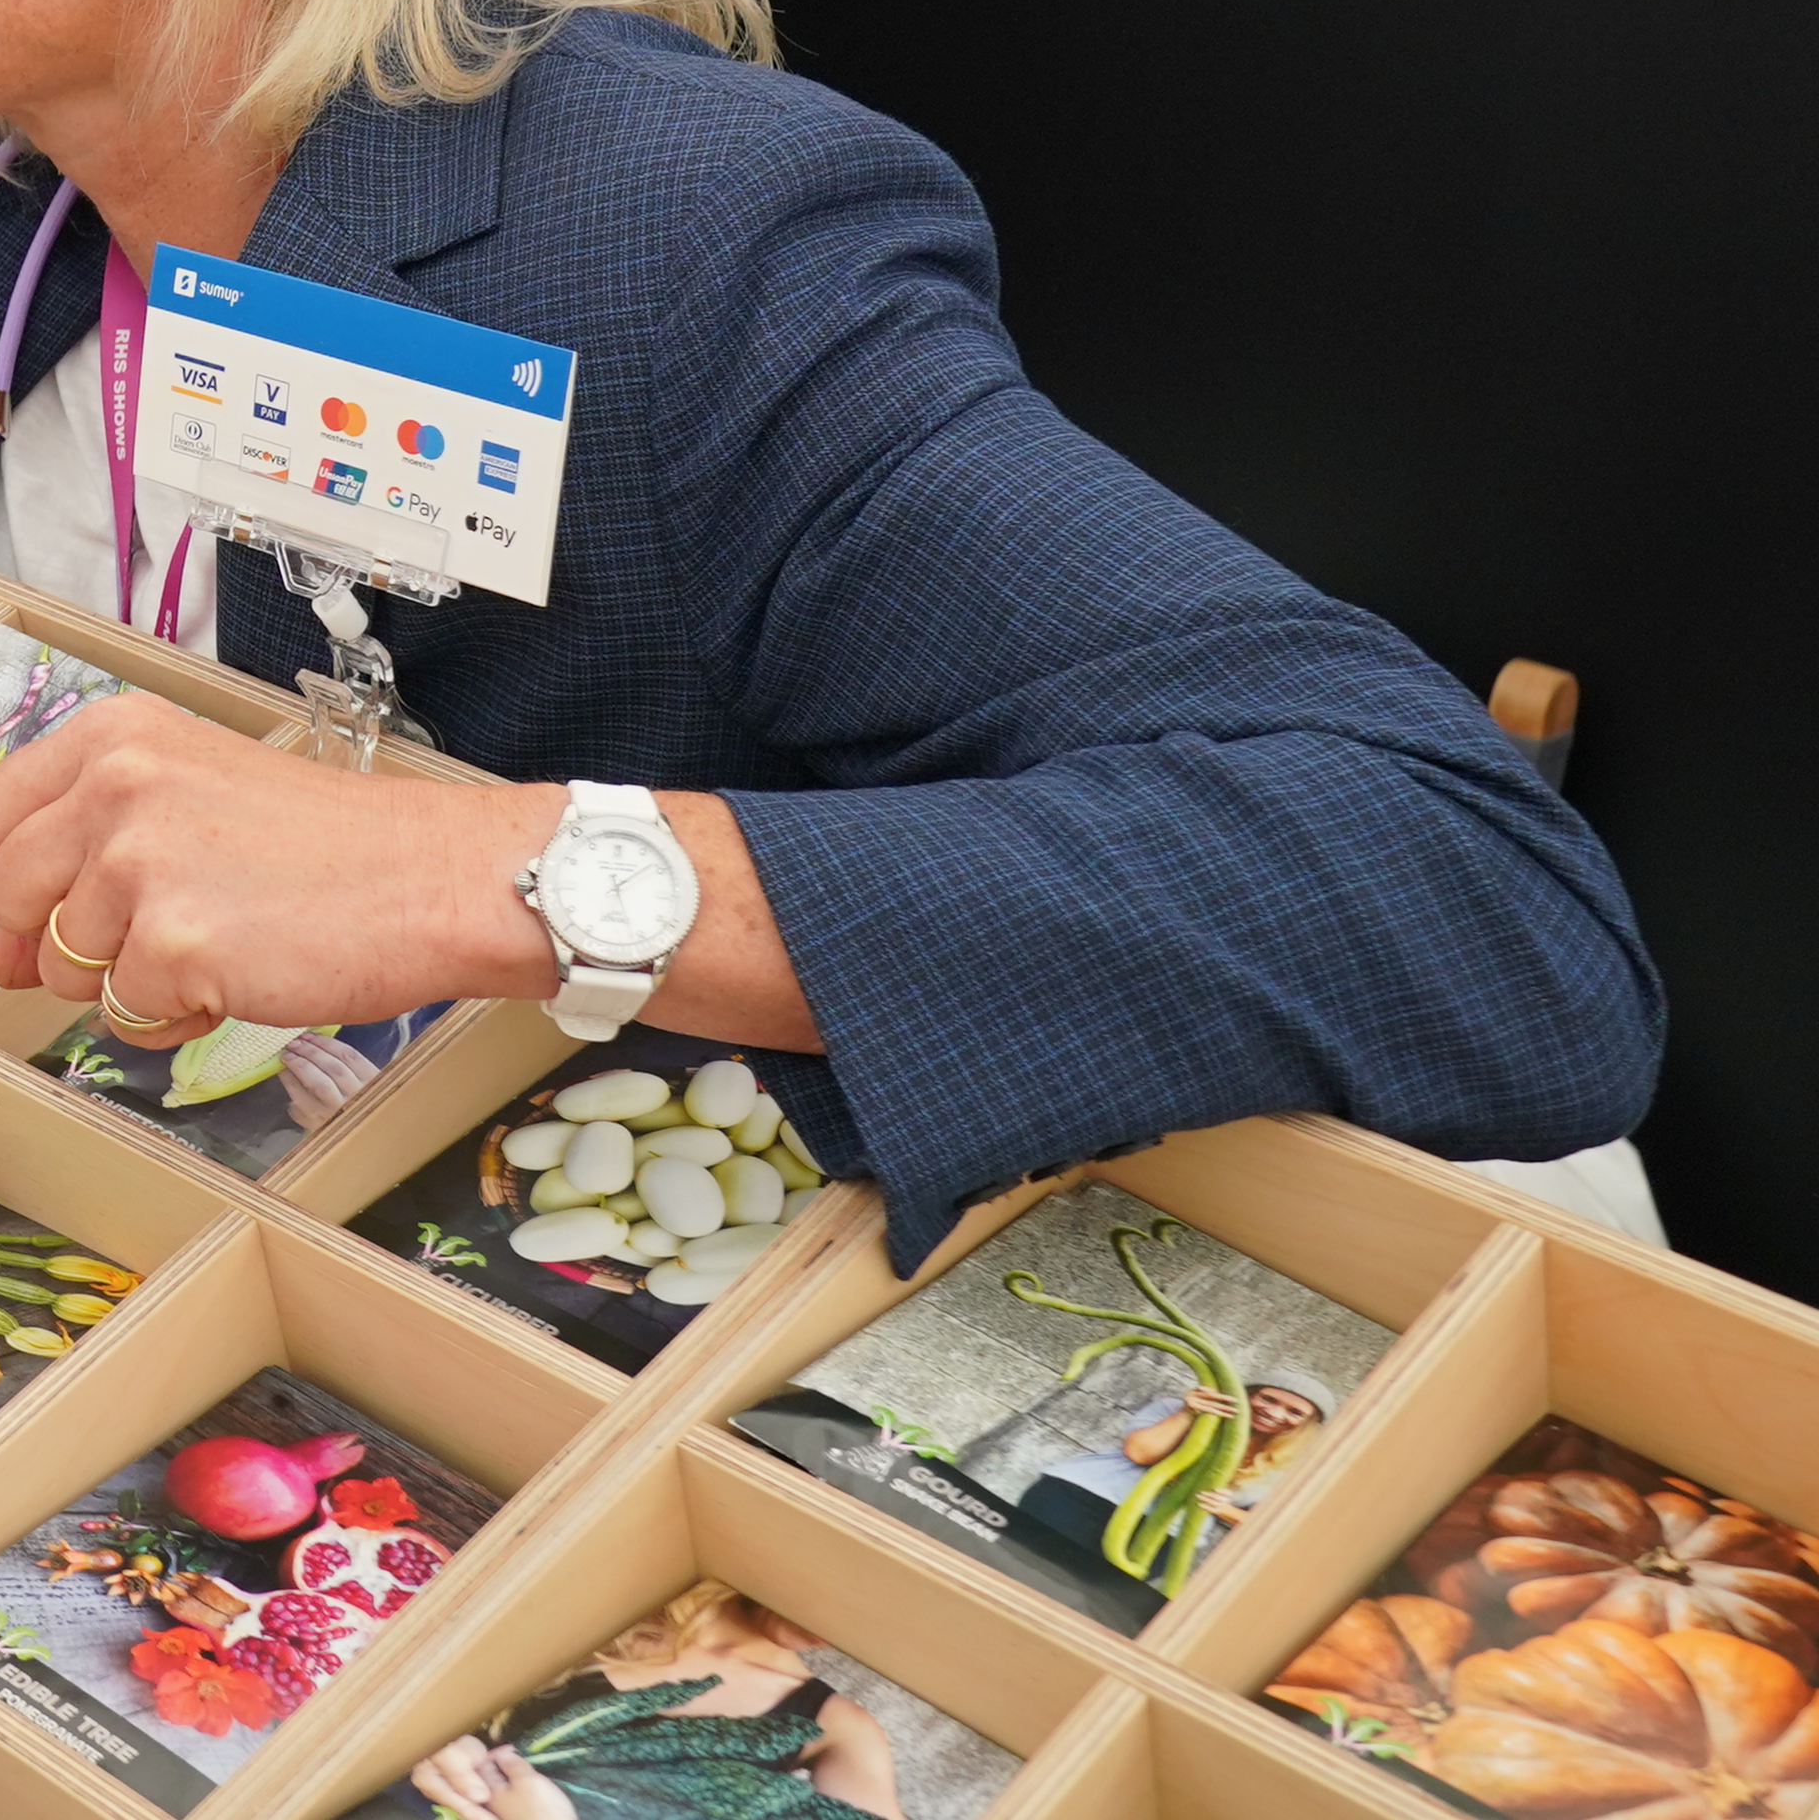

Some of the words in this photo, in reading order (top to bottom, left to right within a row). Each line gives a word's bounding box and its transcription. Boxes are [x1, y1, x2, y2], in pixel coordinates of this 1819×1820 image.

[113, 328, 131, 373] RHS
[179, 365, 219, 392] VISA
[262, 381, 280, 403] V
[113, 380, 127, 461] SHOWS
[260, 406, 281, 421] PAY
[196, 441, 212, 452] Club
[320, 431, 363, 450] mastercard
[242, 445, 288, 467] DISCOVER
[401, 455, 435, 471] maestro
[479, 453, 517, 471] AMERICAN
[319, 466, 363, 491] UnionPay
[485, 466, 518, 481] EXPRESS
[409, 492, 441, 524] Pay
[480, 516, 516, 548] Pay
[908, 1466, 1008, 1528] GOURD
[76, 1714, 141, 1765] TREE
